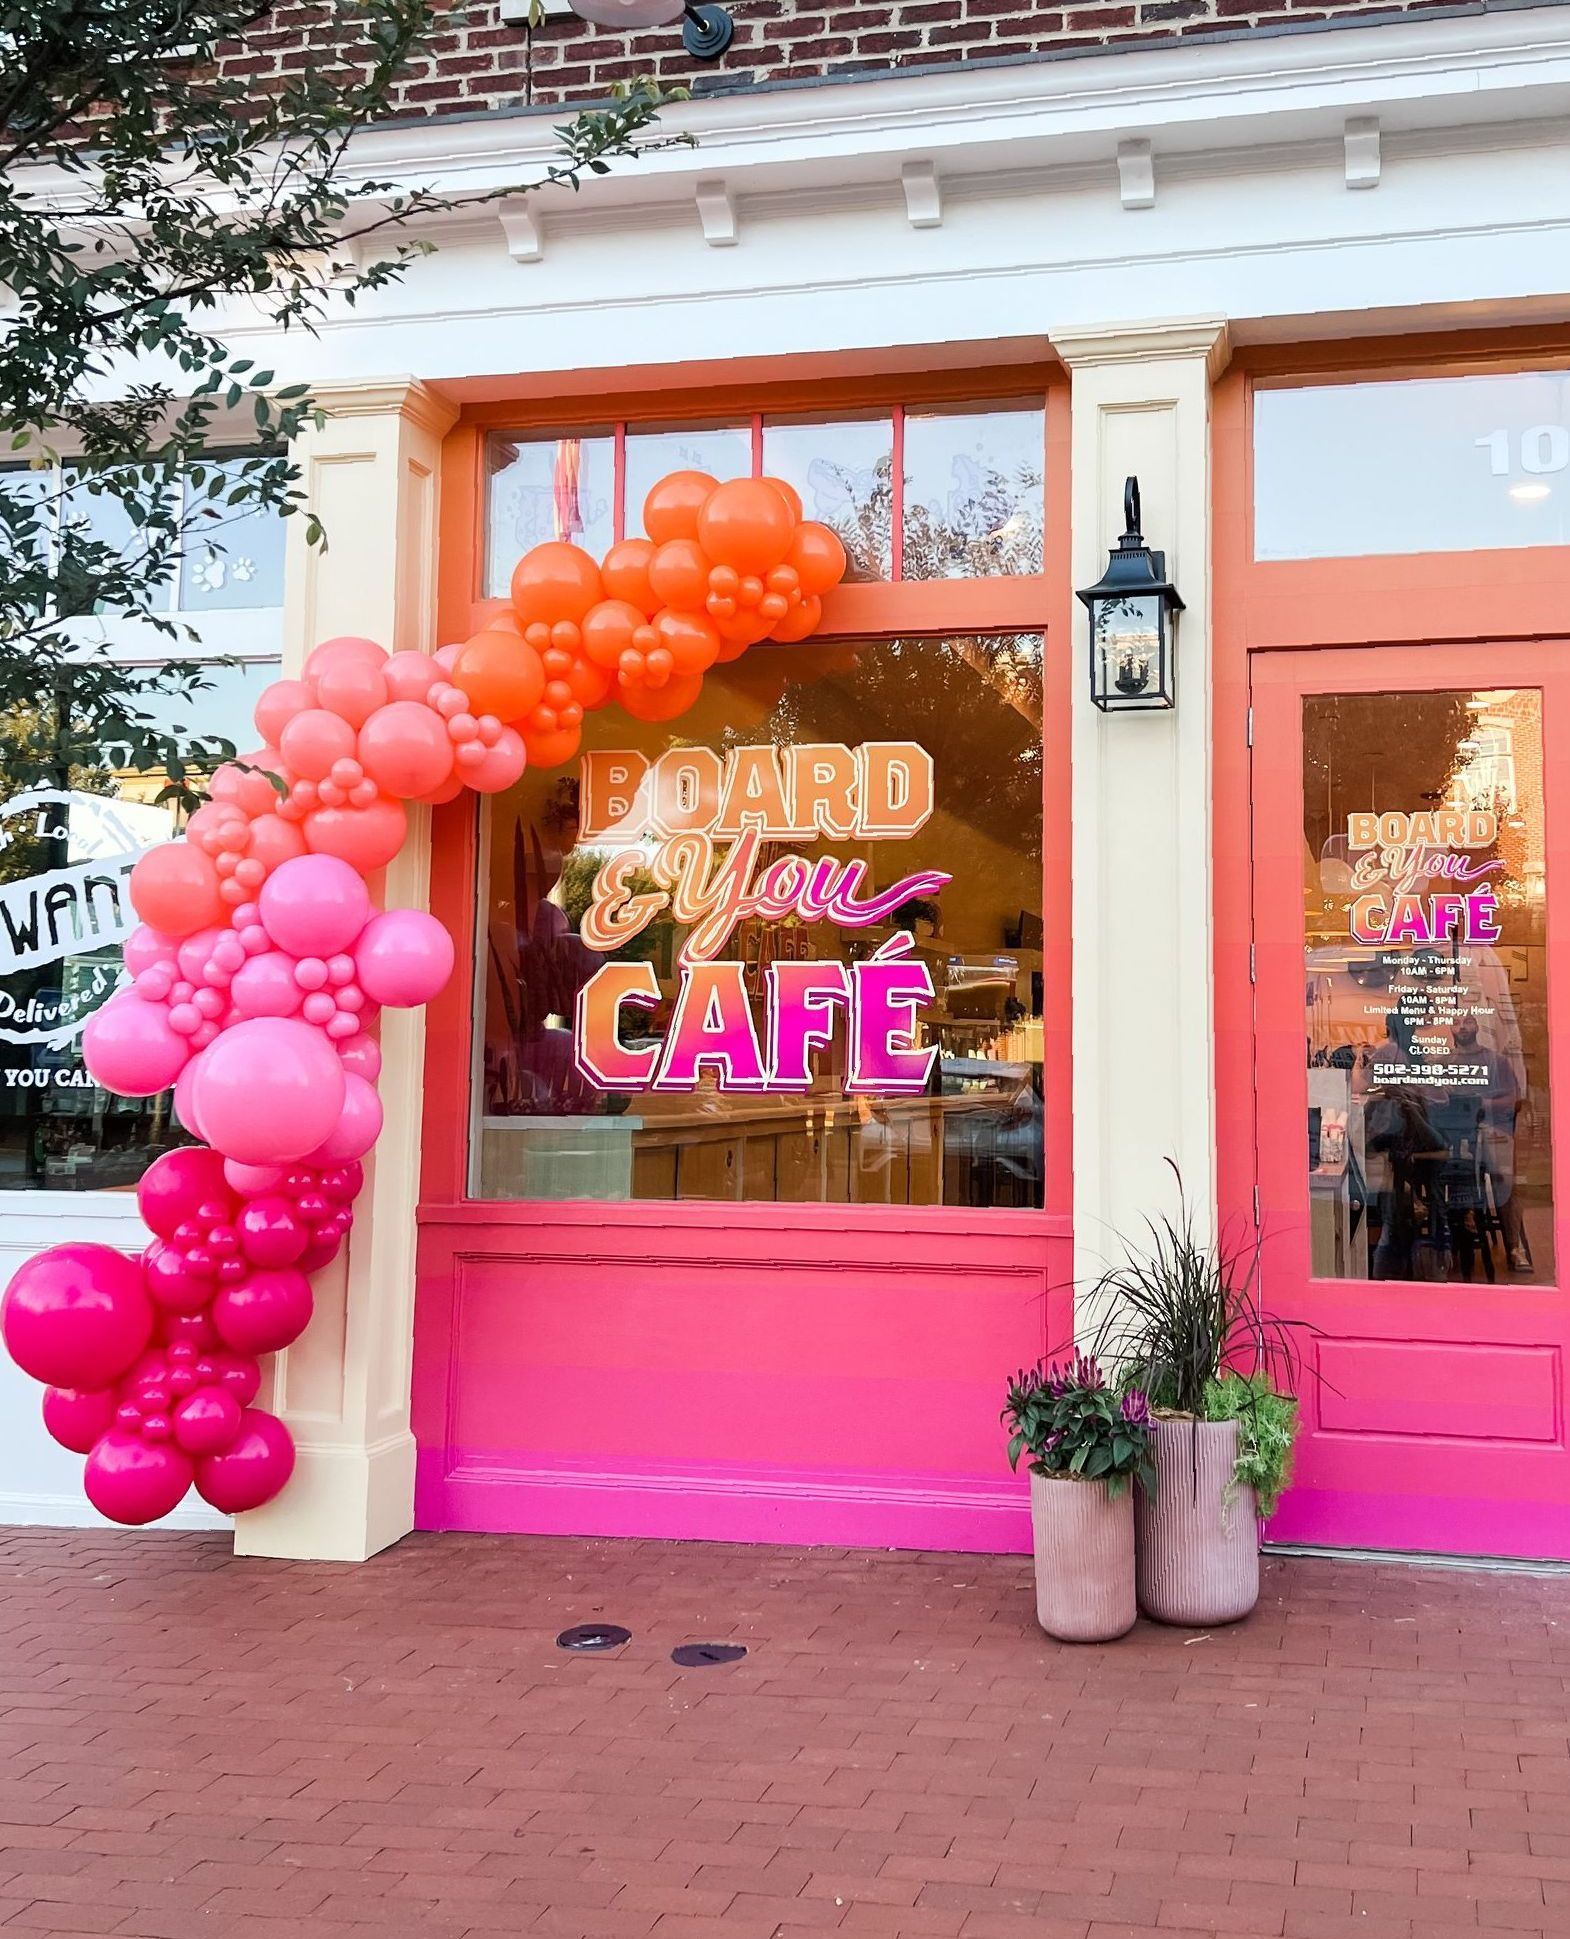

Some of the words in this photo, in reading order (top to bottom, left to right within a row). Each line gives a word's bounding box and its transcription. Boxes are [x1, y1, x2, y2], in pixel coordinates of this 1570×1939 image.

[578, 742, 935, 842] BOARD
[1348, 811, 1497, 849] BOARD
[1380, 844, 1506, 896] You
[652, 827, 954, 967] You
[1350, 882, 1502, 945] CAFÉ
[1382, 956, 1420, 966] Monday
[1428, 956, 1472, 966] Thursday
[1400, 967, 1427, 975] 10AM
[1435, 967, 1455, 975] 6PM
[0, 966, 107, 1023] Delivered
[1388, 985, 1418, 995] Friday
[1426, 985, 1469, 995] Saturday
[1401, 996, 1427, 1004] 10AM
[574, 930, 940, 1096] CAFÉ
[1363, 1006, 1399, 1014] Limited
[1401, 1006, 1426, 1014] Menu
[1428, 1006, 1436, 1014] &
[1438, 1006, 1469, 1016] Happy
[1471, 1006, 1495, 1015] Hour
[1404, 1017, 1424, 1026] 6PM
[1411, 1035, 1448, 1045] Sunday
[1408, 1046, 1450, 1055] CLOSED
[4, 1069, 50, 1087] YOU
[1373, 1075, 1489, 1087] boardandyou.com
